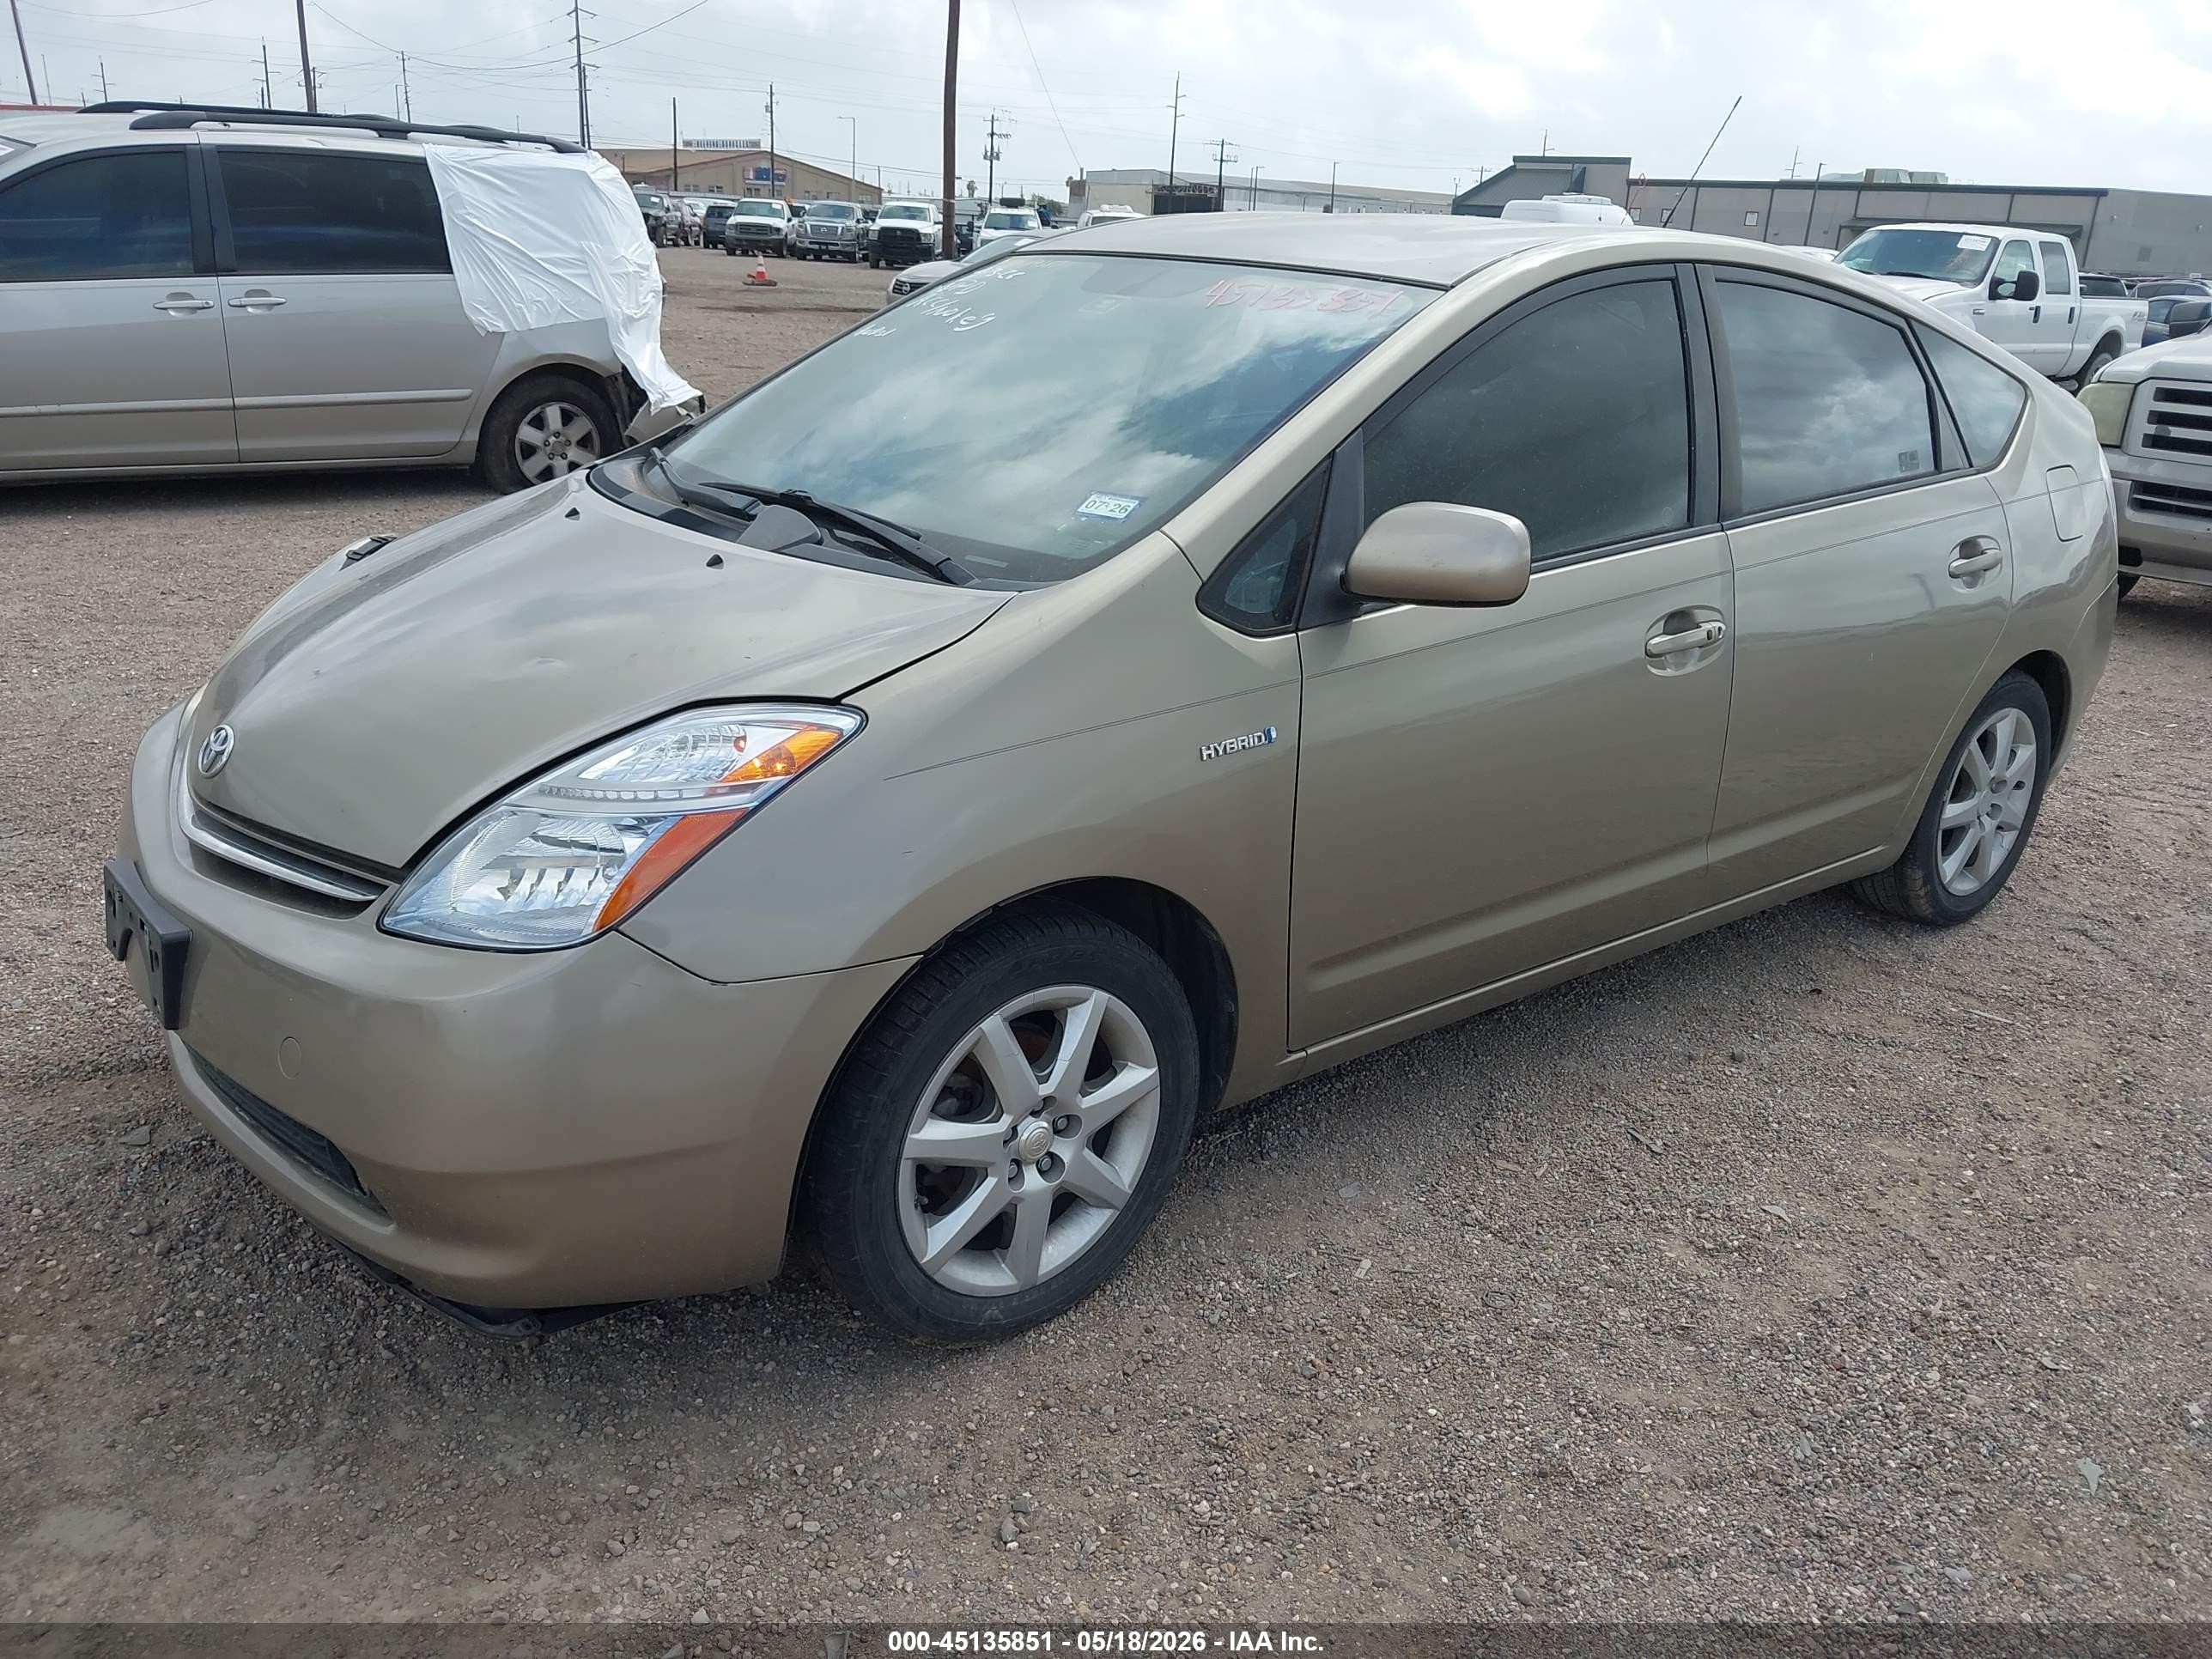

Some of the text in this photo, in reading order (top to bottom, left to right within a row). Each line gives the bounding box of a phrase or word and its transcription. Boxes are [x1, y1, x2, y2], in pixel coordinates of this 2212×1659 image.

[1085, 500, 1132, 514] 07 26
[1200, 732, 1266, 762] HYBRID
